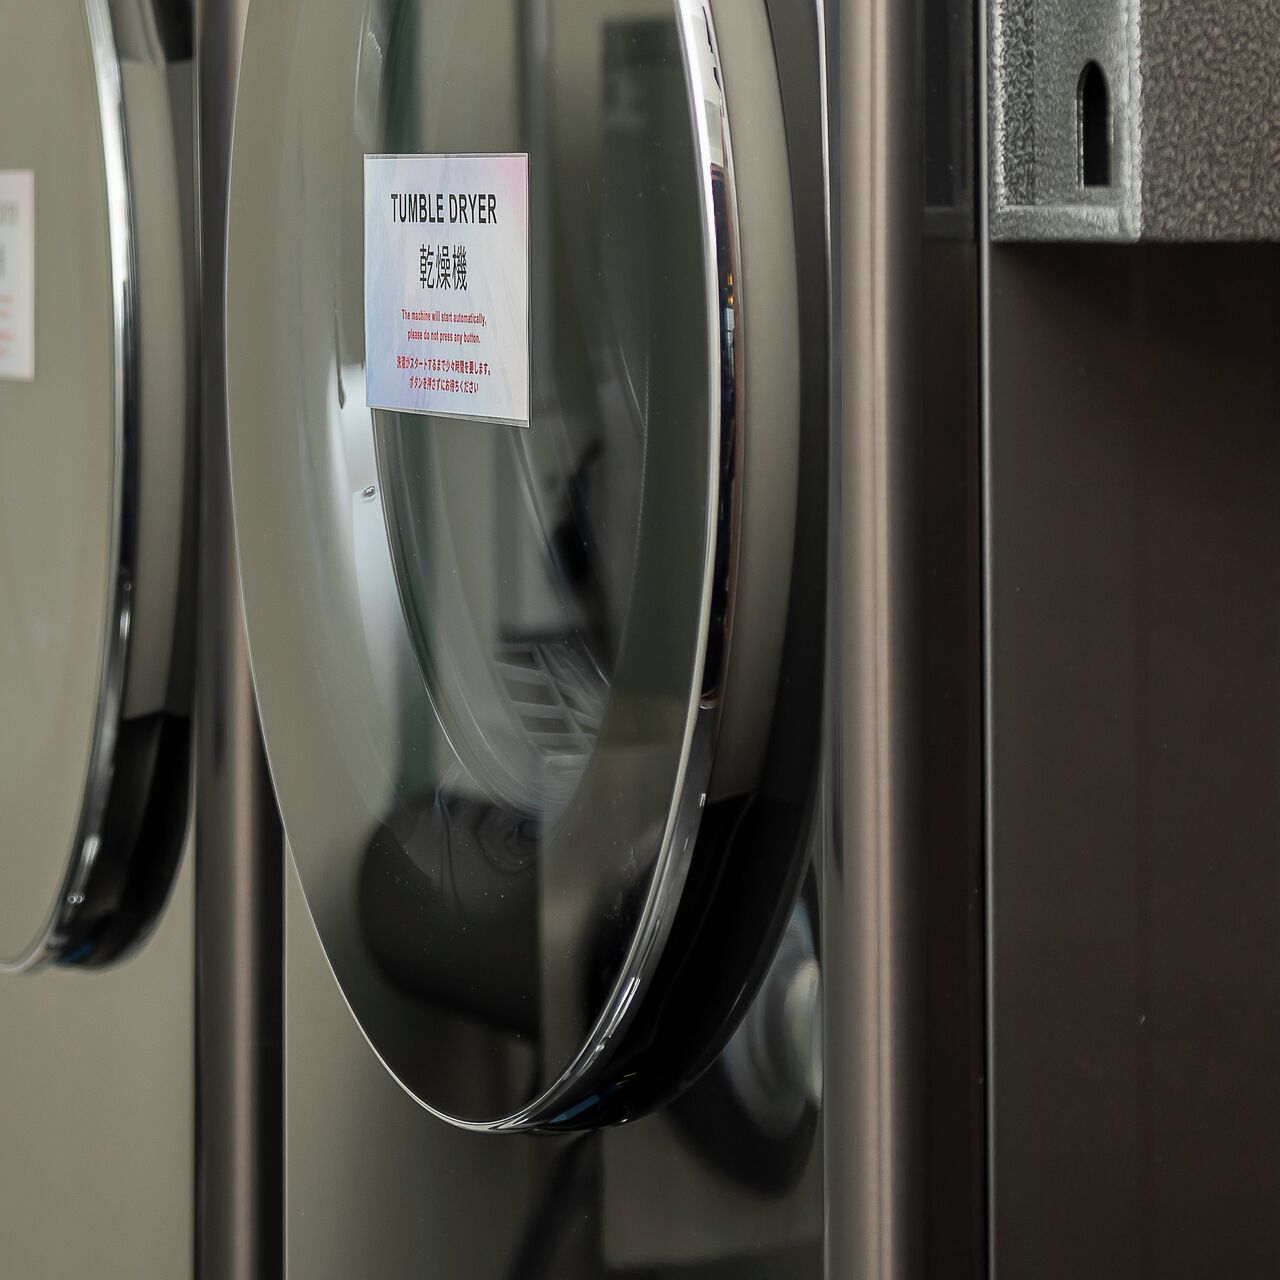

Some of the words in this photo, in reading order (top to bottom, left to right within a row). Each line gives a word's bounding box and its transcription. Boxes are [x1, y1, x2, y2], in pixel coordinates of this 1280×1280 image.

[391, 193, 444, 223] TUMBLE
[449, 194, 497, 224] DRYER
[420, 244, 467, 291] 乾燥機
[402, 309, 410, 320] The
[411, 310, 431, 321] machine
[431, 311, 440, 321] will
[441, 312, 452, 322] start
[407, 328, 423, 341] please
[423, 329, 430, 340] do
[431, 331, 439, 340] not
[440, 332, 453, 343] press
[454, 333, 463, 345] any
[464, 332, 480, 343] button.
